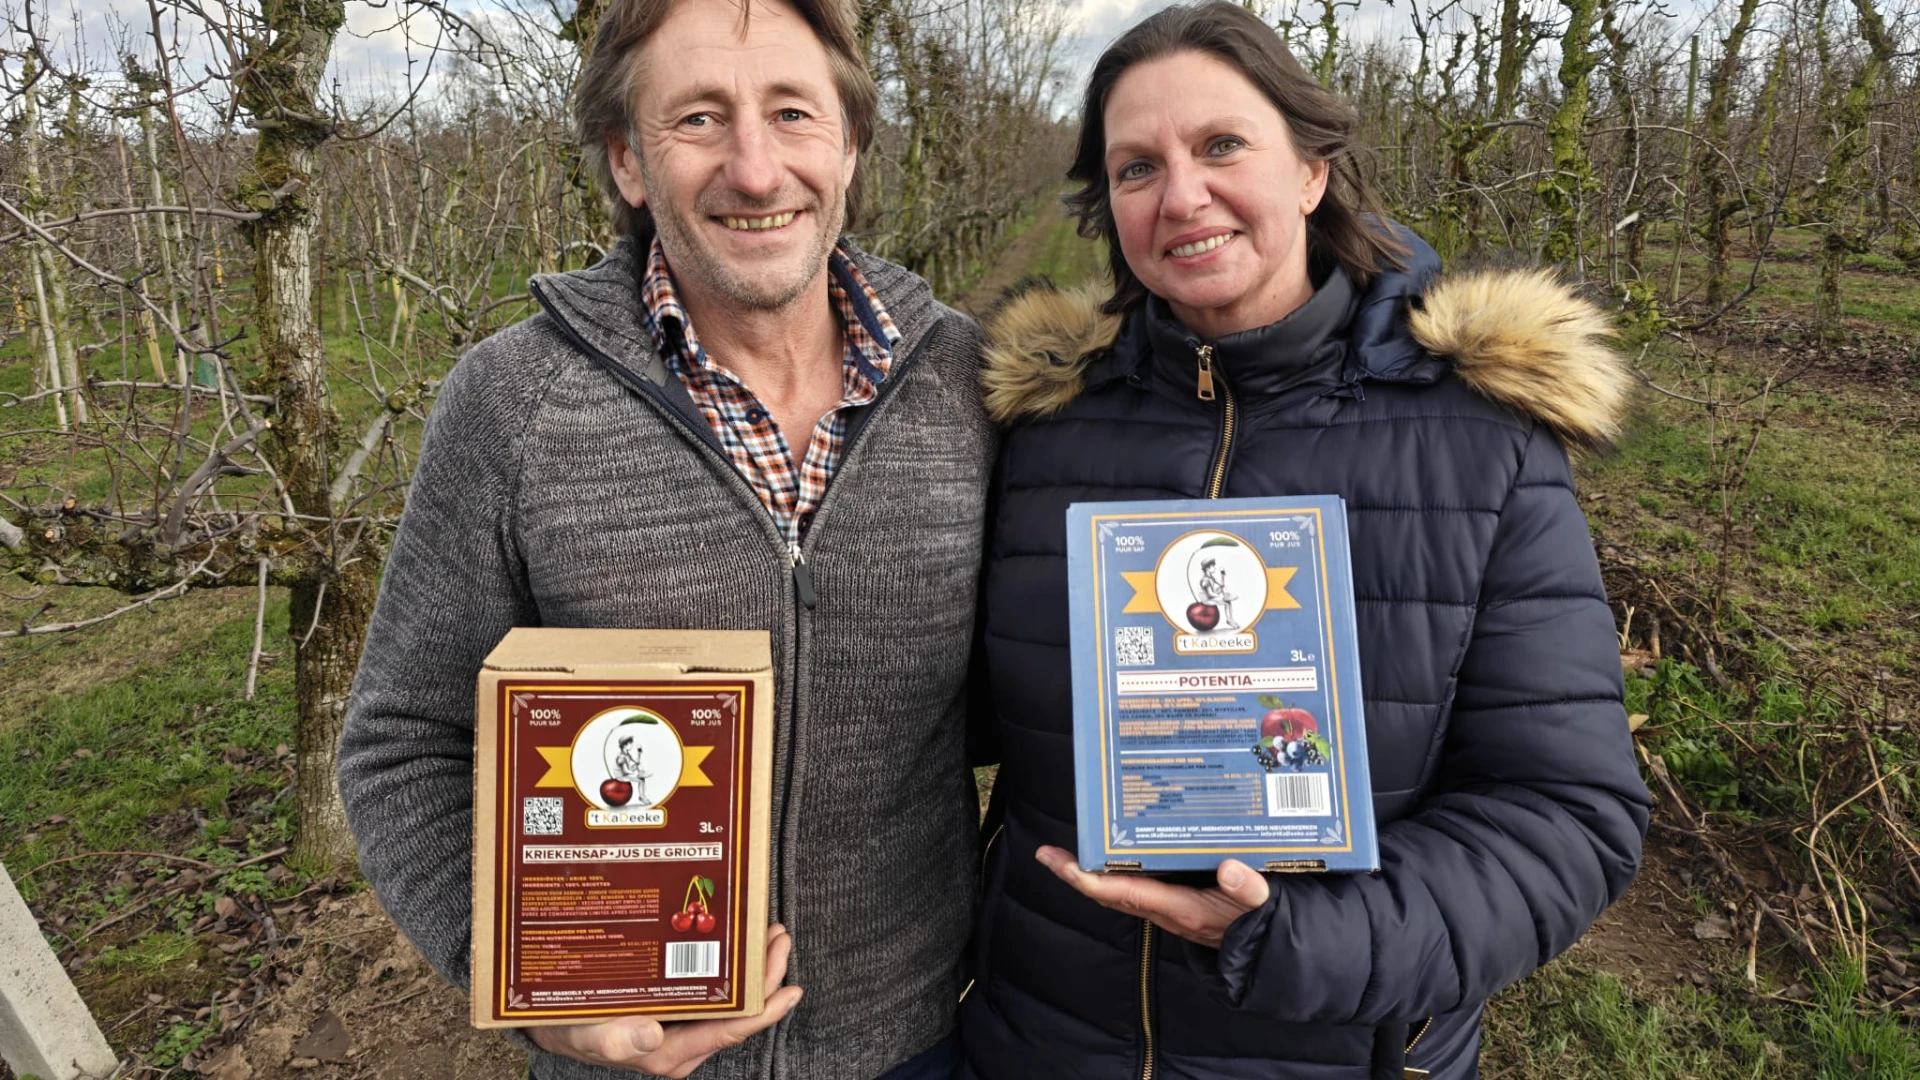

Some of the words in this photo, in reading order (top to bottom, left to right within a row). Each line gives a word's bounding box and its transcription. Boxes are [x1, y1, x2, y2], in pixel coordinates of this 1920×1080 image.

[1115, 536, 1145, 547] 100%
[1269, 530, 1300, 542] 100%
[1191, 636, 1252, 648] KaDeeke
[1179, 674, 1253, 687] POTENTIA
[530, 709, 561, 720] 100%
[691, 708, 722, 720] 100%
[602, 812, 661, 823] KaDeeke
[643, 847, 661, 858] DE
[664, 846, 720, 857] GRIOTTE
